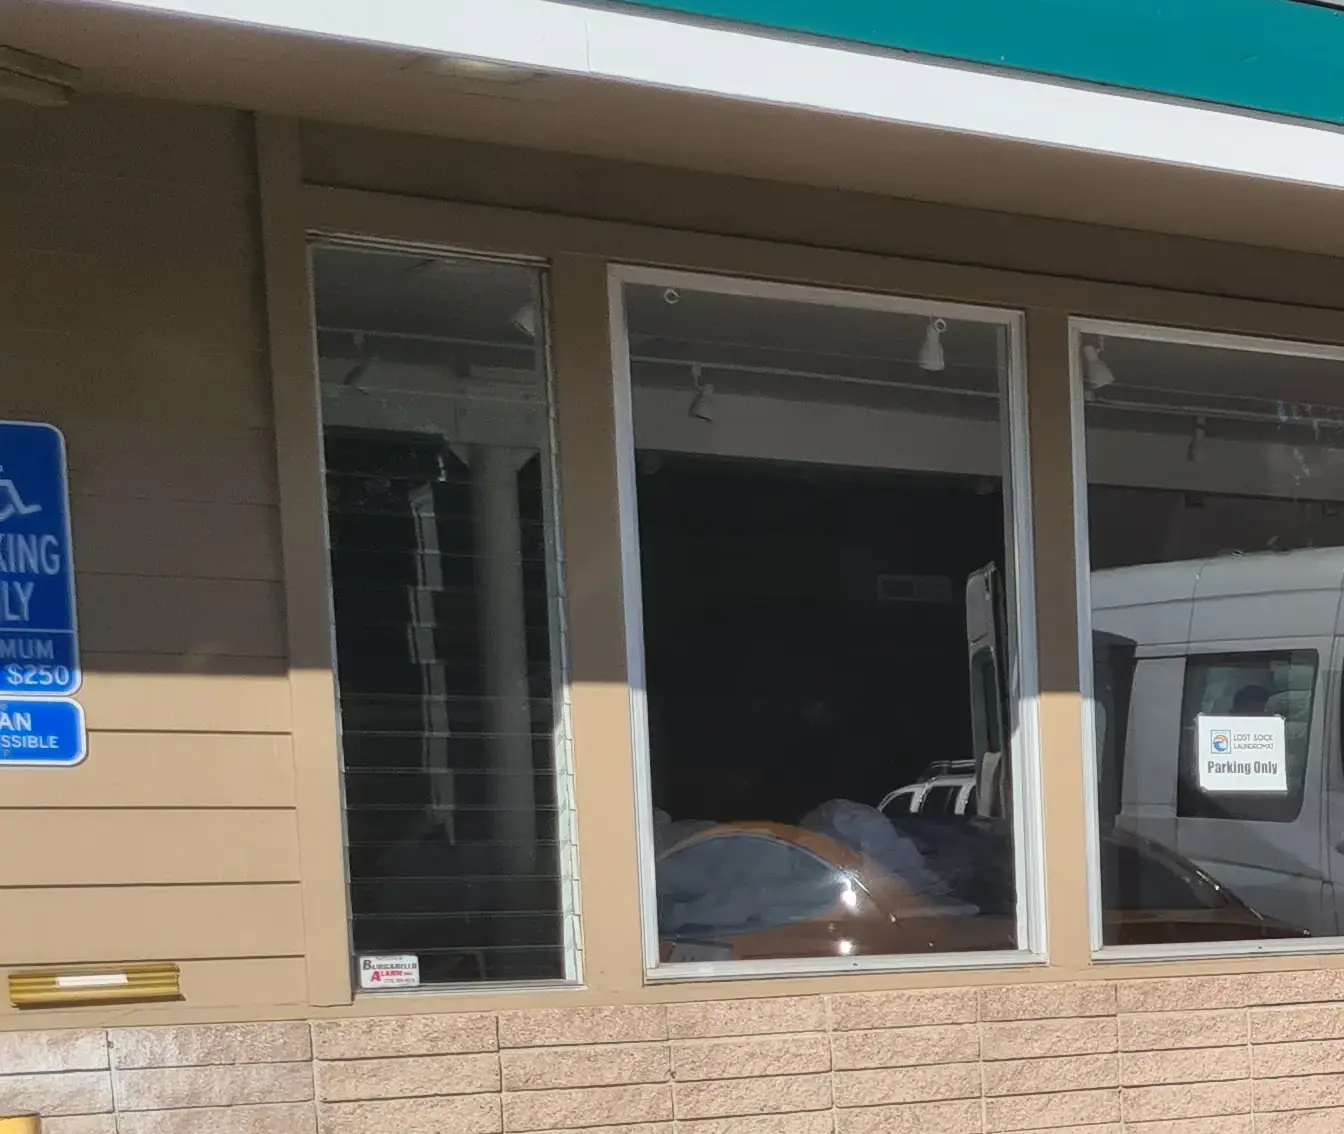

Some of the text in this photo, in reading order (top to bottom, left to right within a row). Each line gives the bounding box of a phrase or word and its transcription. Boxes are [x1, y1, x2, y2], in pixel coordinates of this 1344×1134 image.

[6, 664, 70, 687] $250
[1233, 733, 1274, 742] LOST SOCK
[1207, 761, 1278, 775] Parking Only
